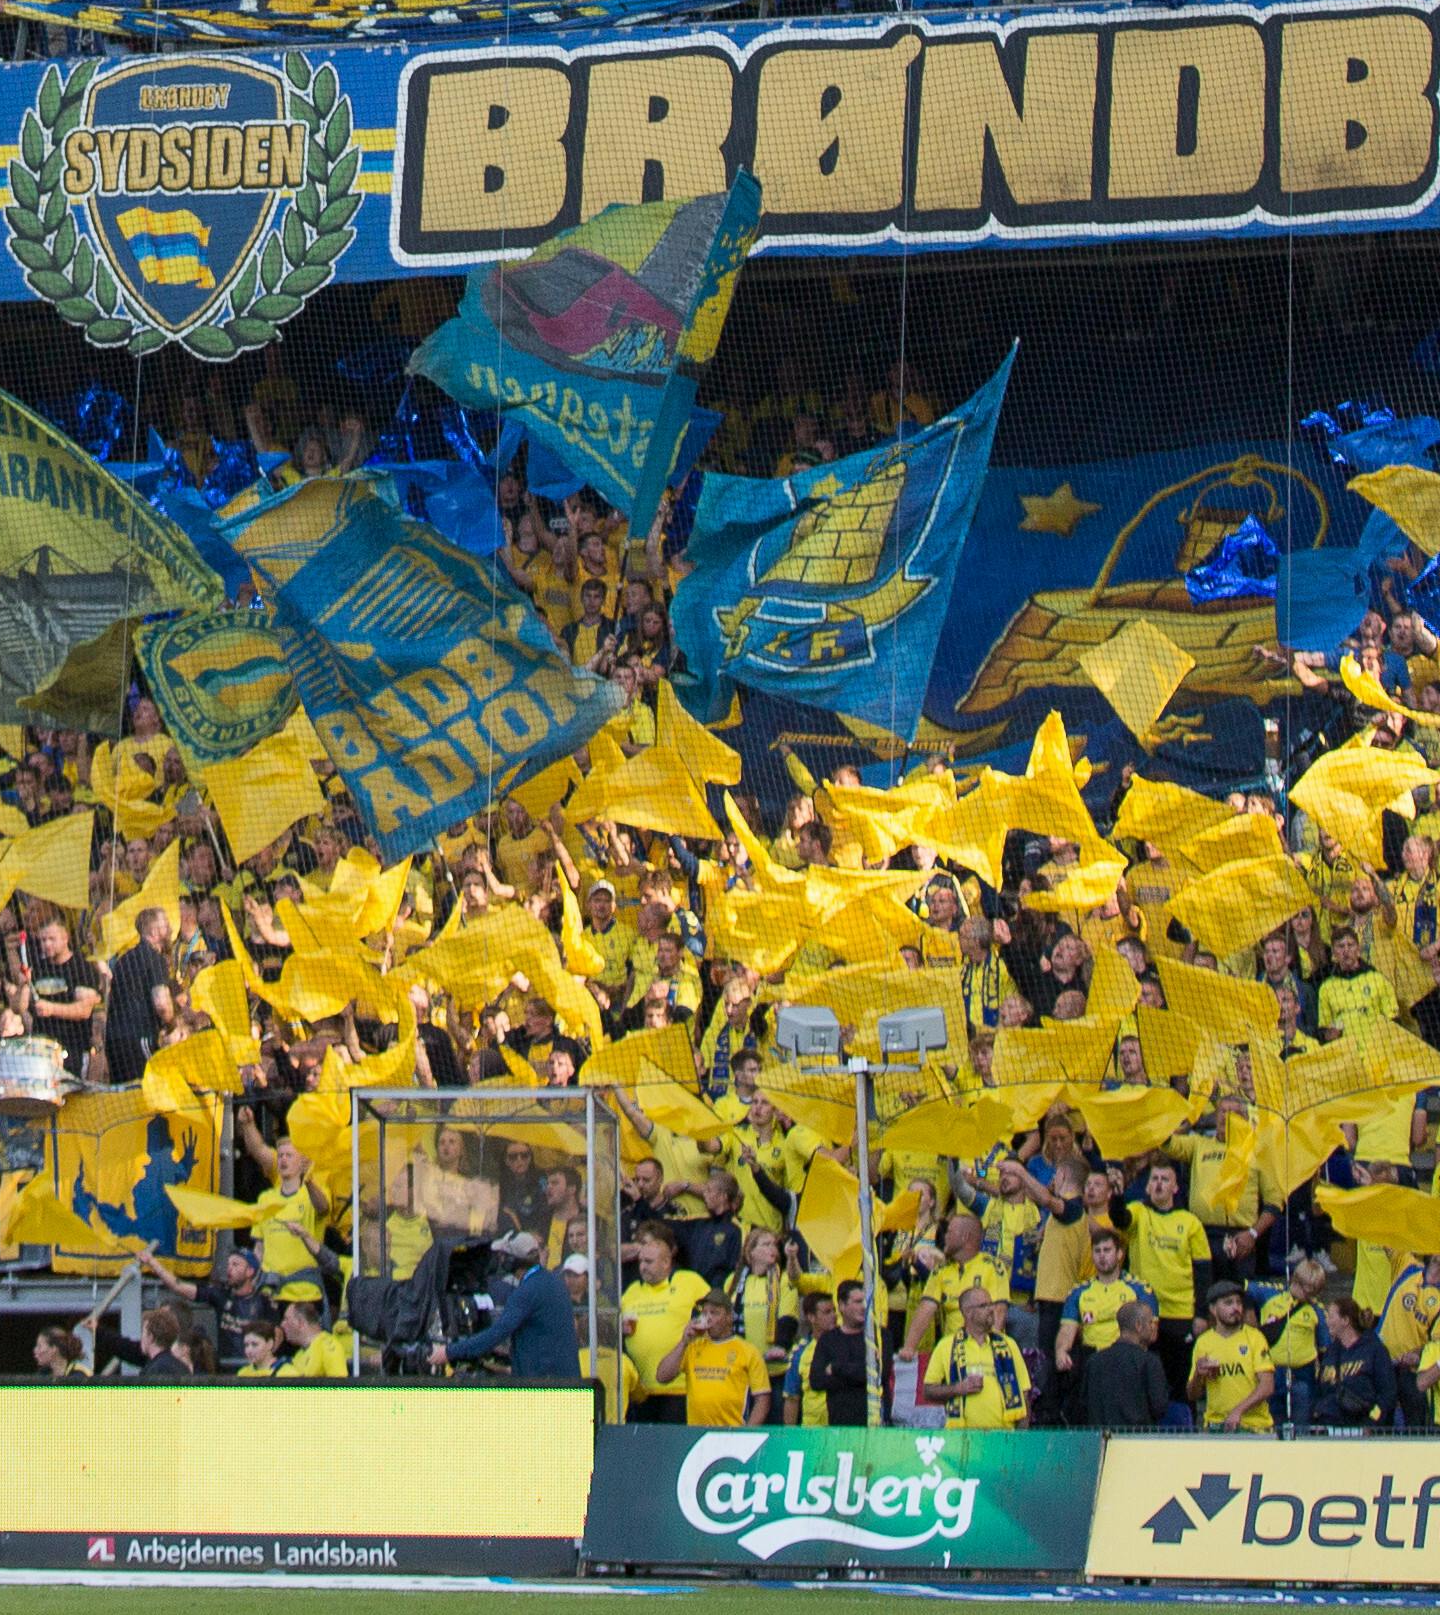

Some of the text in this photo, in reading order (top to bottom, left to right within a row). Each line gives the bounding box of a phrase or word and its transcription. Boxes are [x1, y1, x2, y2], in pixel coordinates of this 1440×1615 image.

[63, 124, 307, 195] SYDSIDEN
[676, 1432, 976, 1556] Carlsberg
[126, 1538, 264, 1570] Arbejdernes
[274, 1540, 398, 1567] Landsbank
